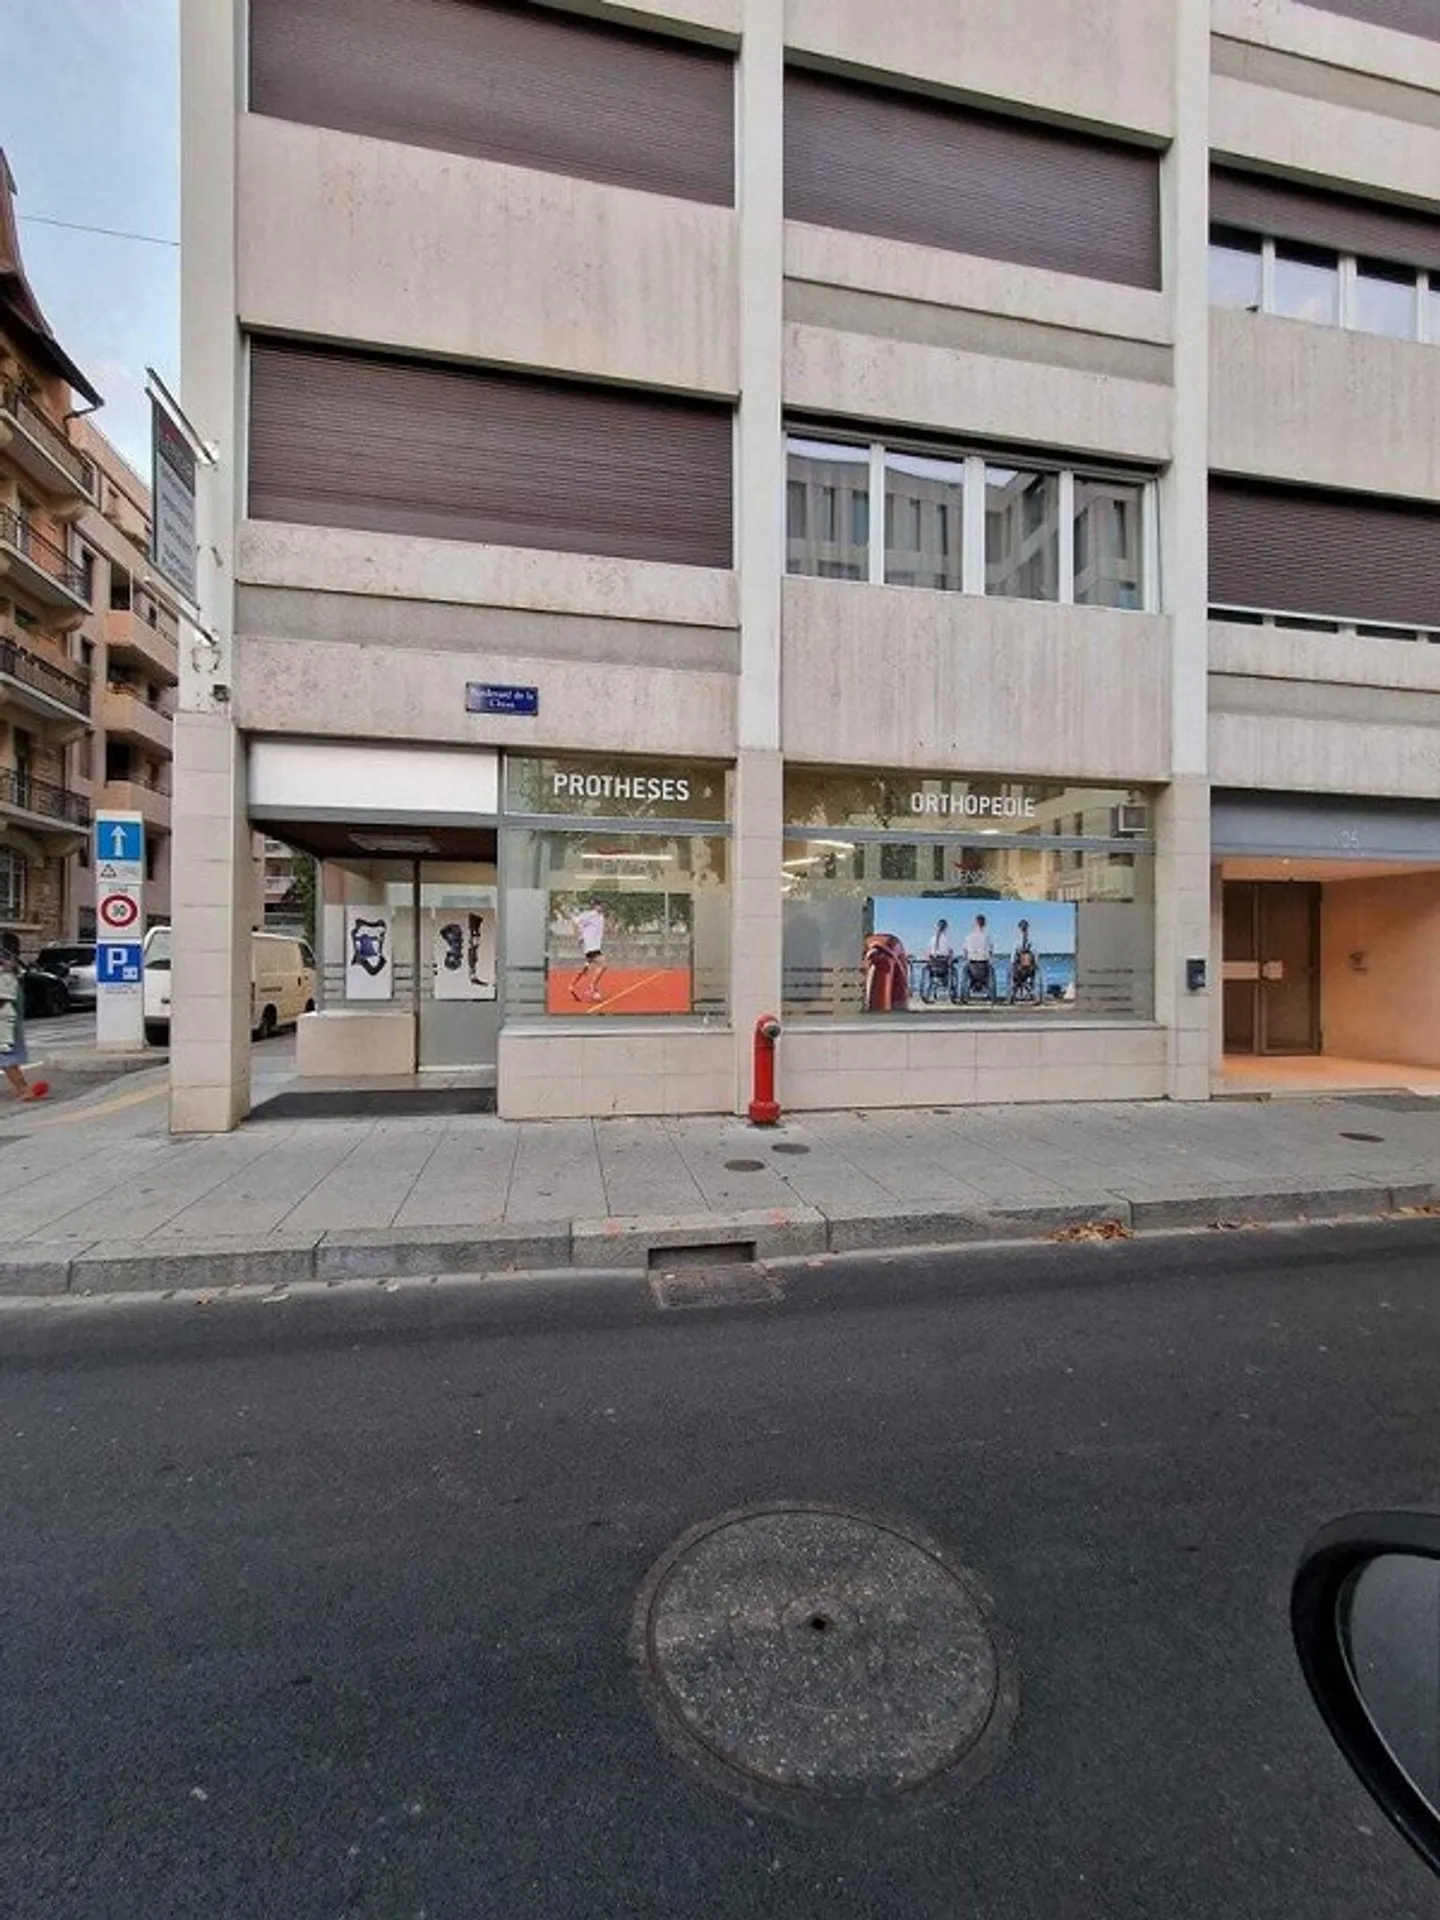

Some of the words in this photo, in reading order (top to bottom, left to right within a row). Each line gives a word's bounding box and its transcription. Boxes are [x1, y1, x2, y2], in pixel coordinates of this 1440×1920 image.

[553, 773, 690, 802] PROTHESES
[910, 792, 1036, 818] ORTHOPEDIE
[107, 948, 128, 976] P
